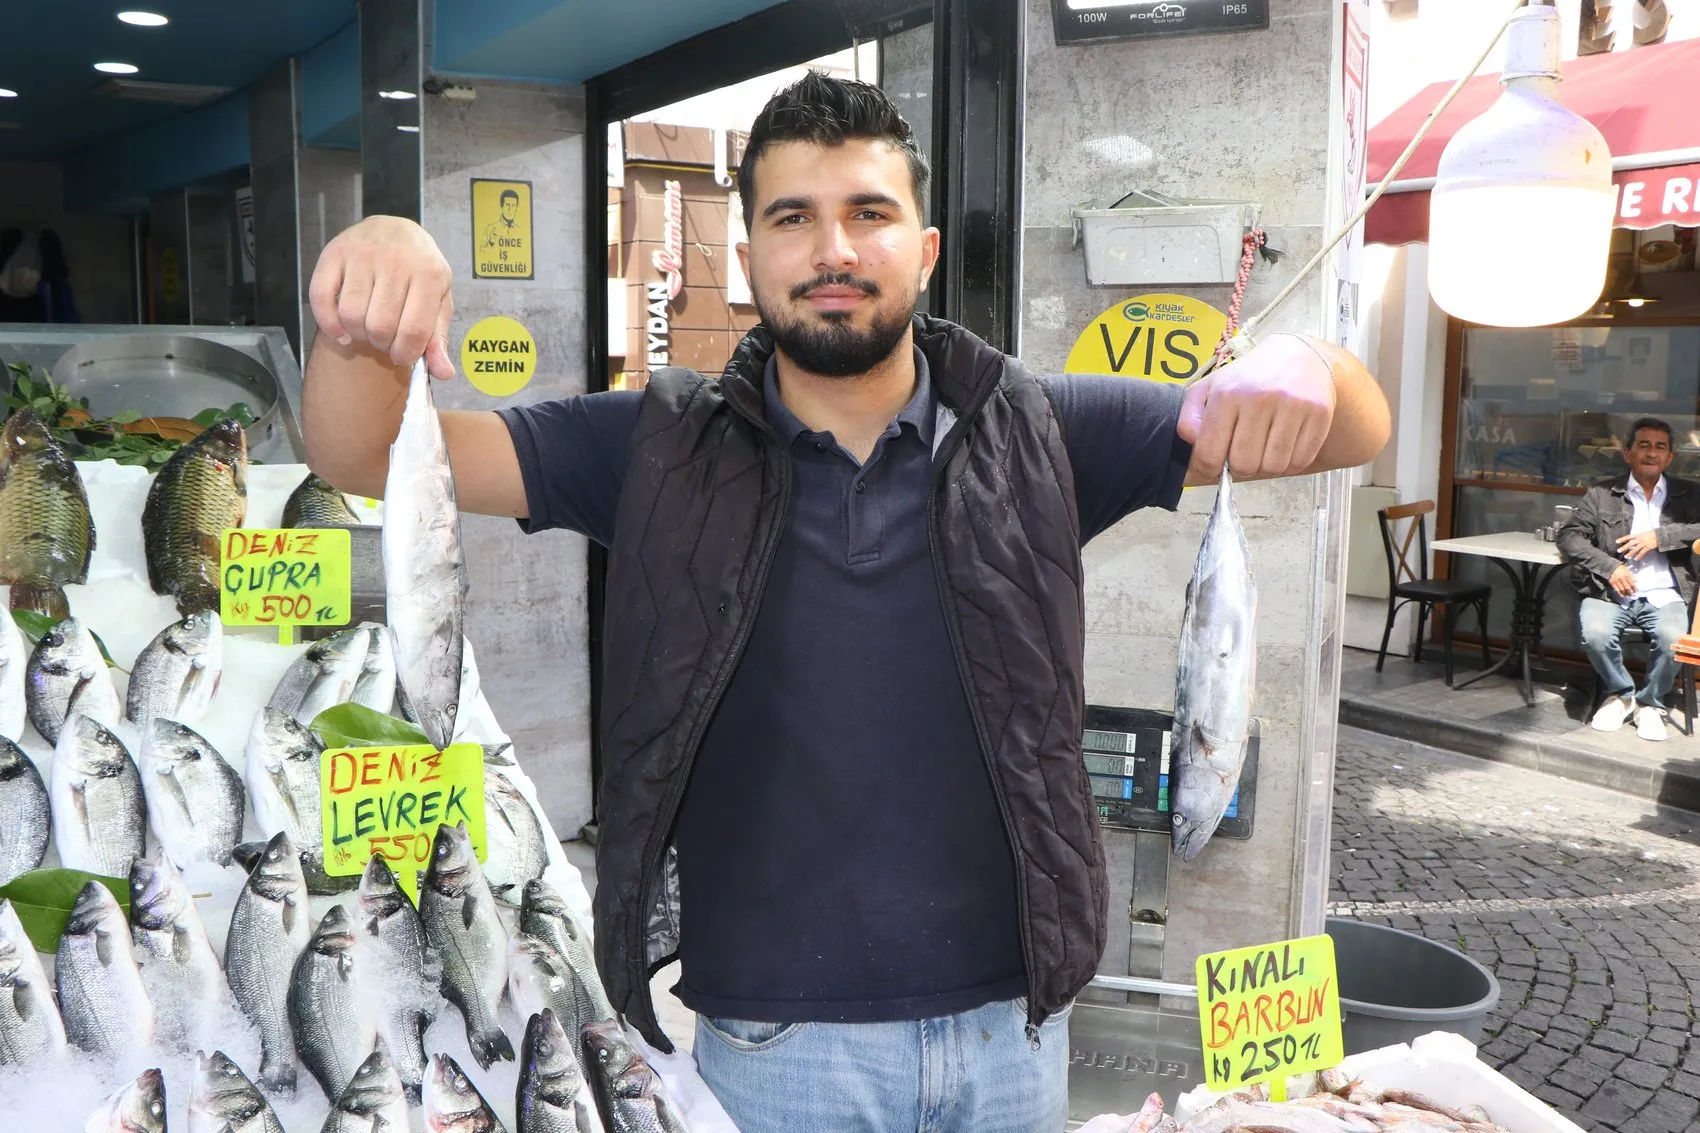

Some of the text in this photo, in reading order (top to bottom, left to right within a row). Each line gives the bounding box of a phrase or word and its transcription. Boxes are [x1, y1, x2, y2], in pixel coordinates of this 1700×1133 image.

[1077, 4, 1248, 23] 100W FORLIFE IP65
[1661, 177, 1700, 215] R
[481, 261, 527, 273] GÜVENLİĞİ
[468, 340, 530, 353] KAYGAN
[474, 358, 525, 373] ZEMİN
[255, 594, 312, 622] 500
[316, 606, 338, 622] TL
[332, 785, 472, 846] LEVREK
[360, 832, 431, 866] 550
[1207, 976, 1330, 1049] BARBUN
[1241, 1034, 1297, 1082] 250
[1301, 1032, 1321, 1060] TL
